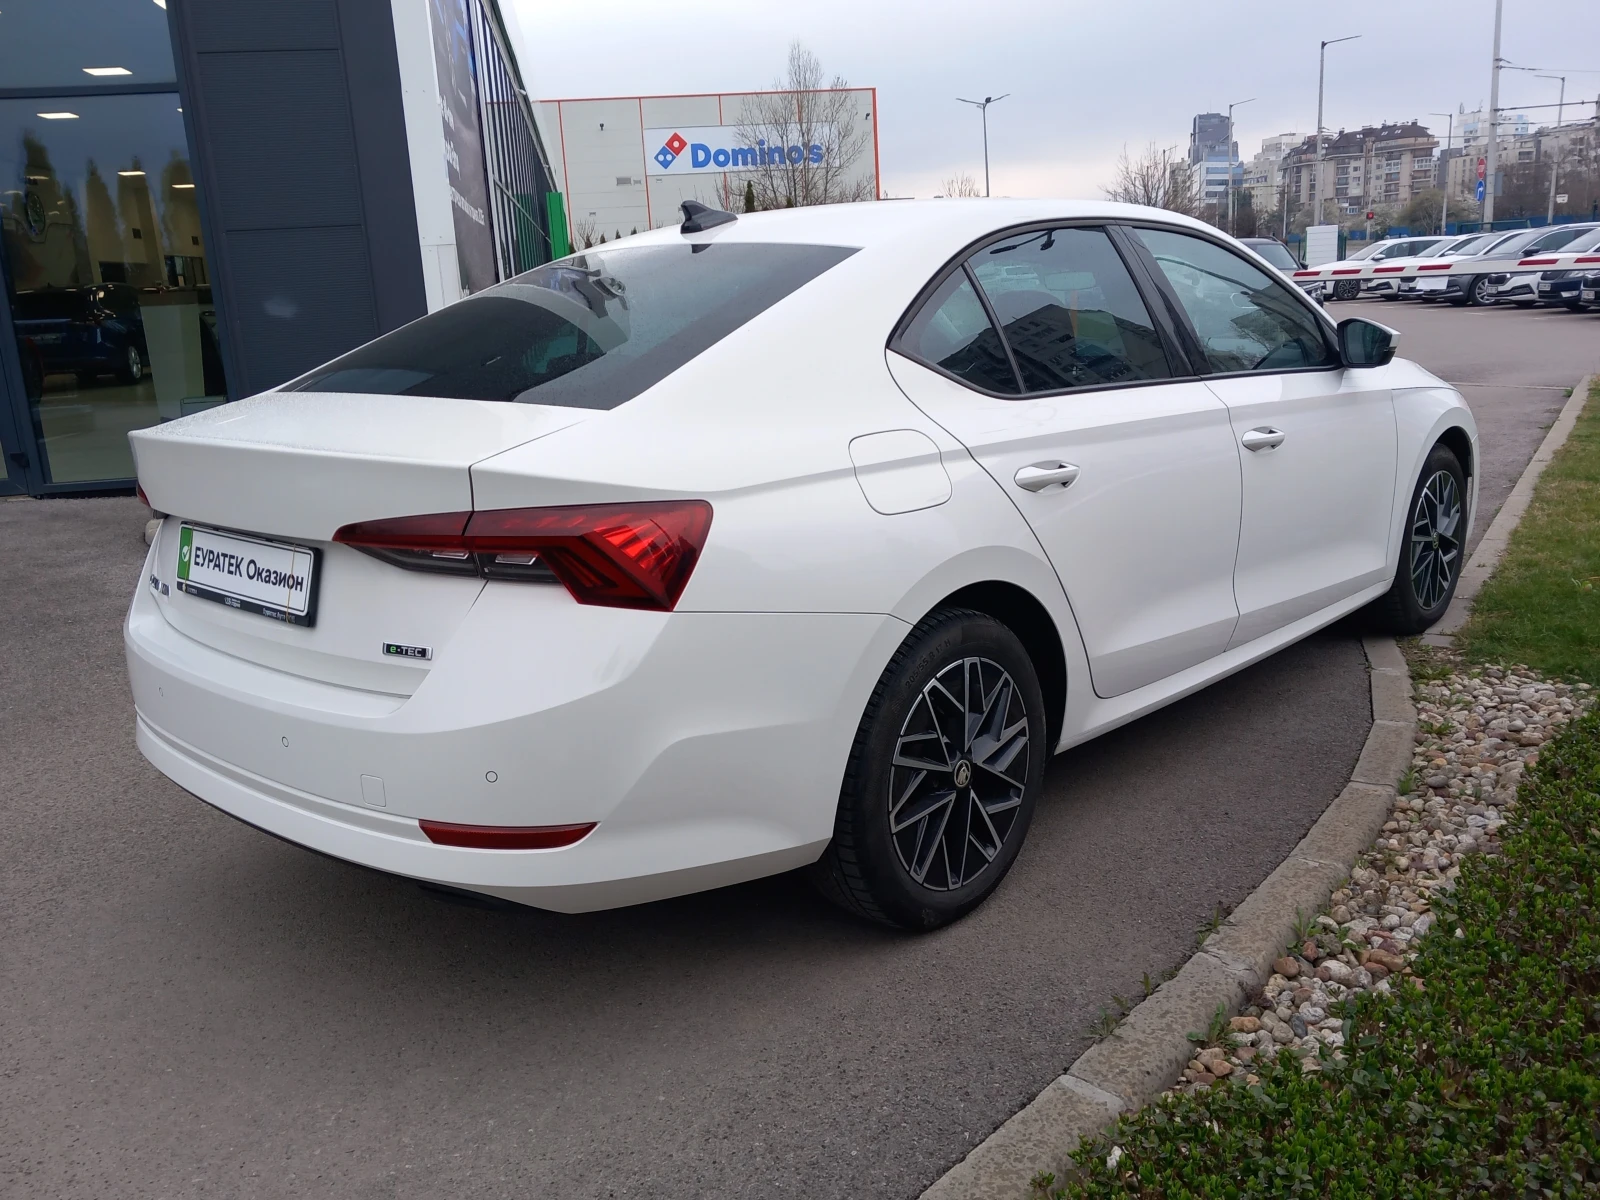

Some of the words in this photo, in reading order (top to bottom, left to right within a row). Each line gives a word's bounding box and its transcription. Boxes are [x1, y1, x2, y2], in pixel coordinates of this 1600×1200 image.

[690, 139, 824, 169] Domino's
[193, 546, 245, 578] ЕУРАТЕК
[246, 559, 304, 592] Оказион
